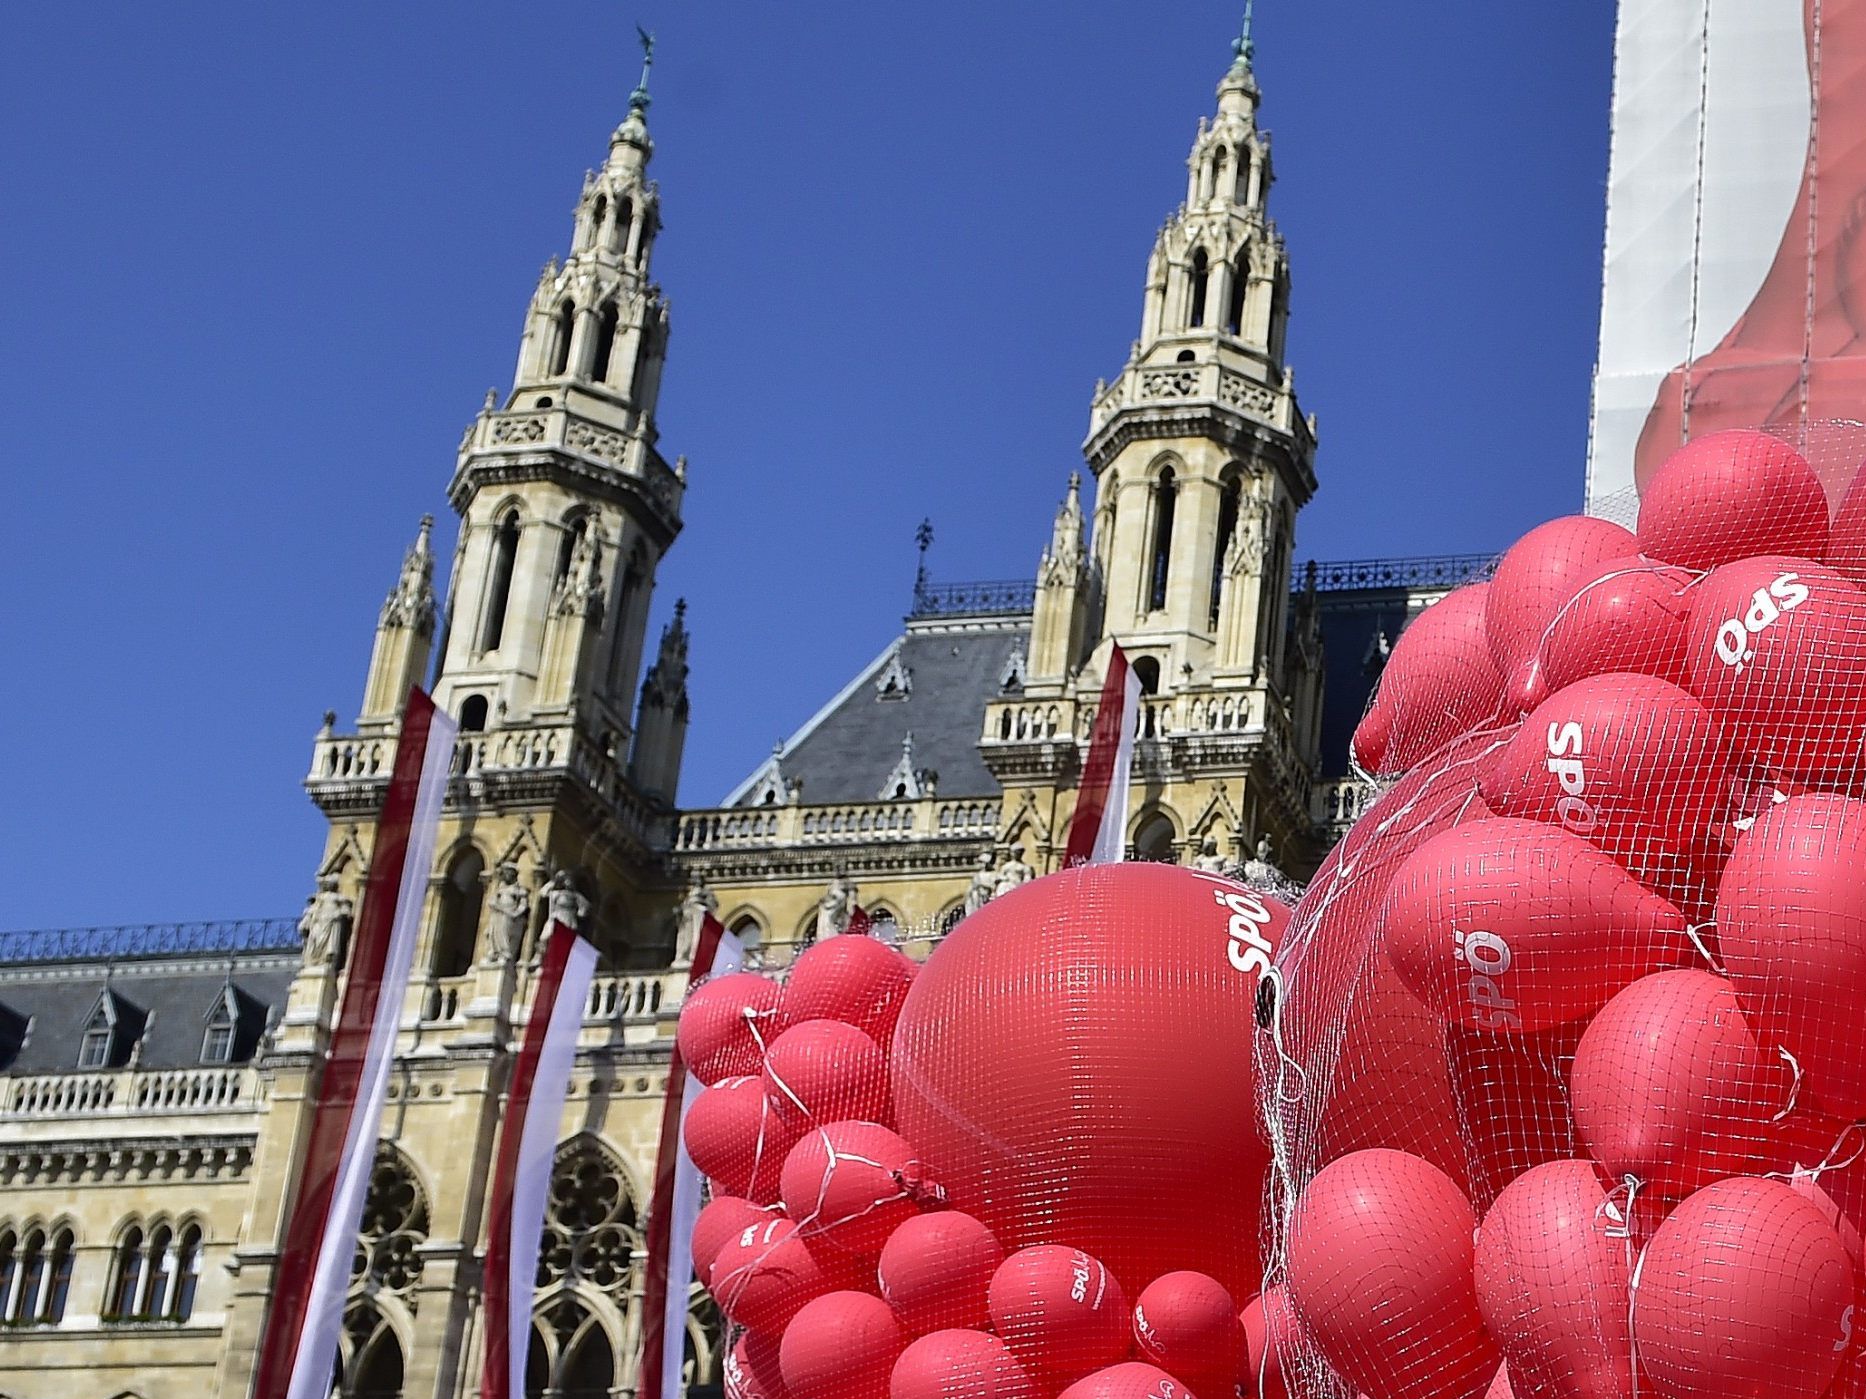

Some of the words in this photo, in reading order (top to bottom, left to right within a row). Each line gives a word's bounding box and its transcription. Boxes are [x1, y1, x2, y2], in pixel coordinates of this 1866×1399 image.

[1714, 571, 1811, 675] SPÖ
[1213, 889, 1273, 978] SPÖ
[1452, 929, 1521, 1030] SPÖ
